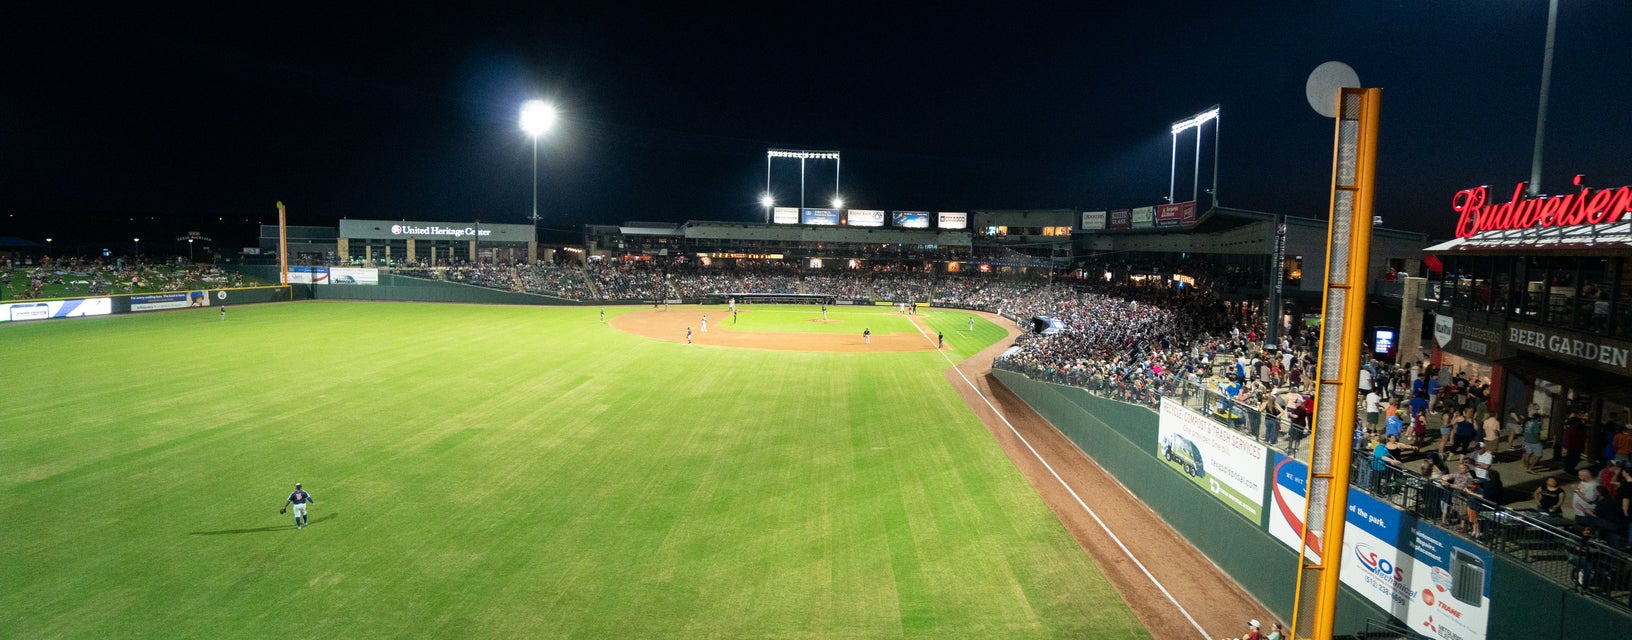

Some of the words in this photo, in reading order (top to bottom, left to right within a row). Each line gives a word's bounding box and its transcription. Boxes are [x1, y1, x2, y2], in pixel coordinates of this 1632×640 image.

[1453, 174, 1632, 238] Budweiser
[402, 226, 430, 235] United
[430, 227, 465, 237] Heritage
[1509, 327, 1546, 349] BEER
[1549, 335, 1630, 368] GARDEN
[1184, 411, 1207, 431] COMPOST
[1213, 425, 1231, 442] TRASH
[1231, 434, 1261, 460] SERVICES
[1211, 459, 1258, 490] texasdisposal.com
[1349, 504, 1356, 512] of
[1357, 507, 1368, 519] the
[1368, 515, 1387, 529] park.
[1370, 552, 1403, 582] SOS
[1373, 567, 1418, 598] Mechanical
[1438, 600, 1463, 619] TRANE
